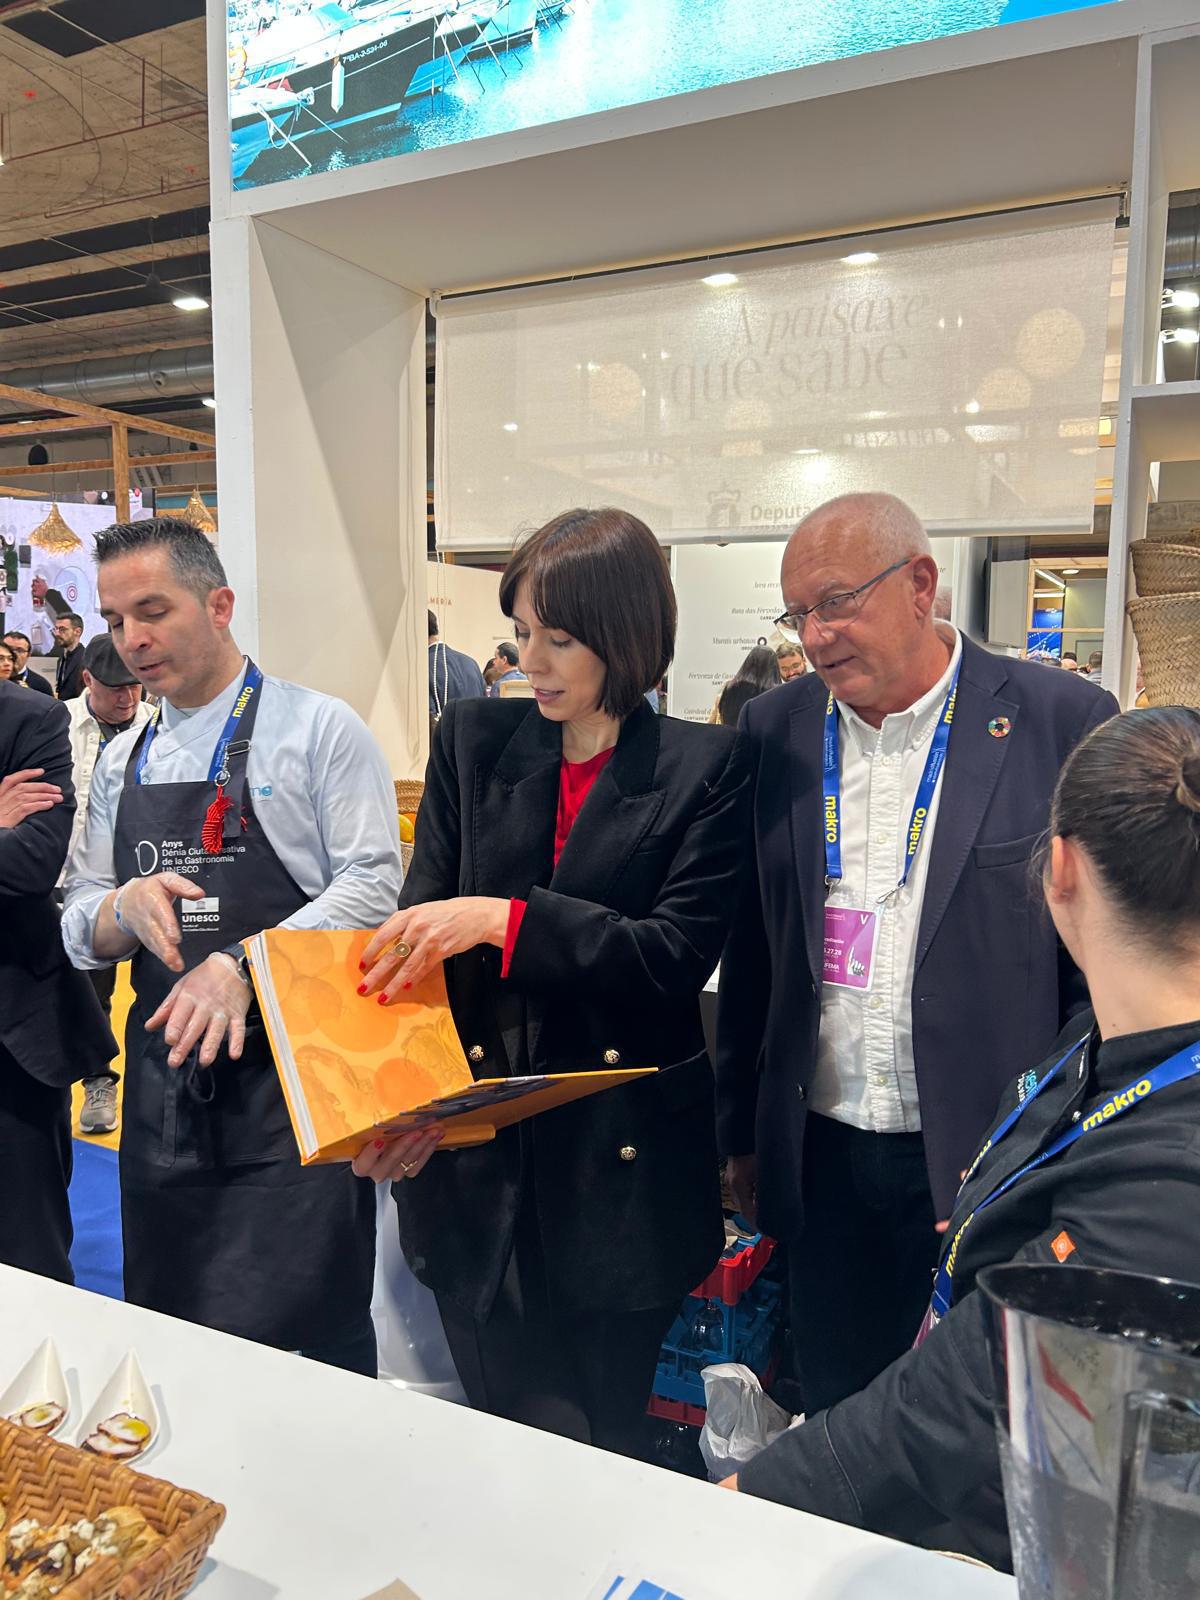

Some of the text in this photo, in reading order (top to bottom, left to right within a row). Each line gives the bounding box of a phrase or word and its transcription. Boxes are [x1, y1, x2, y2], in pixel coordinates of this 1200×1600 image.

[670, 352, 765, 421] que
[751, 504, 812, 524] Deputa
[232, 686, 254, 718] makro
[825, 796, 839, 843] makro
[908, 807, 927, 855] makro
[161, 840, 184, 849] Anys
[162, 848, 187, 857] Dénia
[162, 854, 235, 866] de la Gastronomia
[162, 865, 199, 874] UNESCO
[182, 914, 220, 923] unesco
[860, 914, 869, 925] V
[1082, 1079, 1152, 1131] makro
